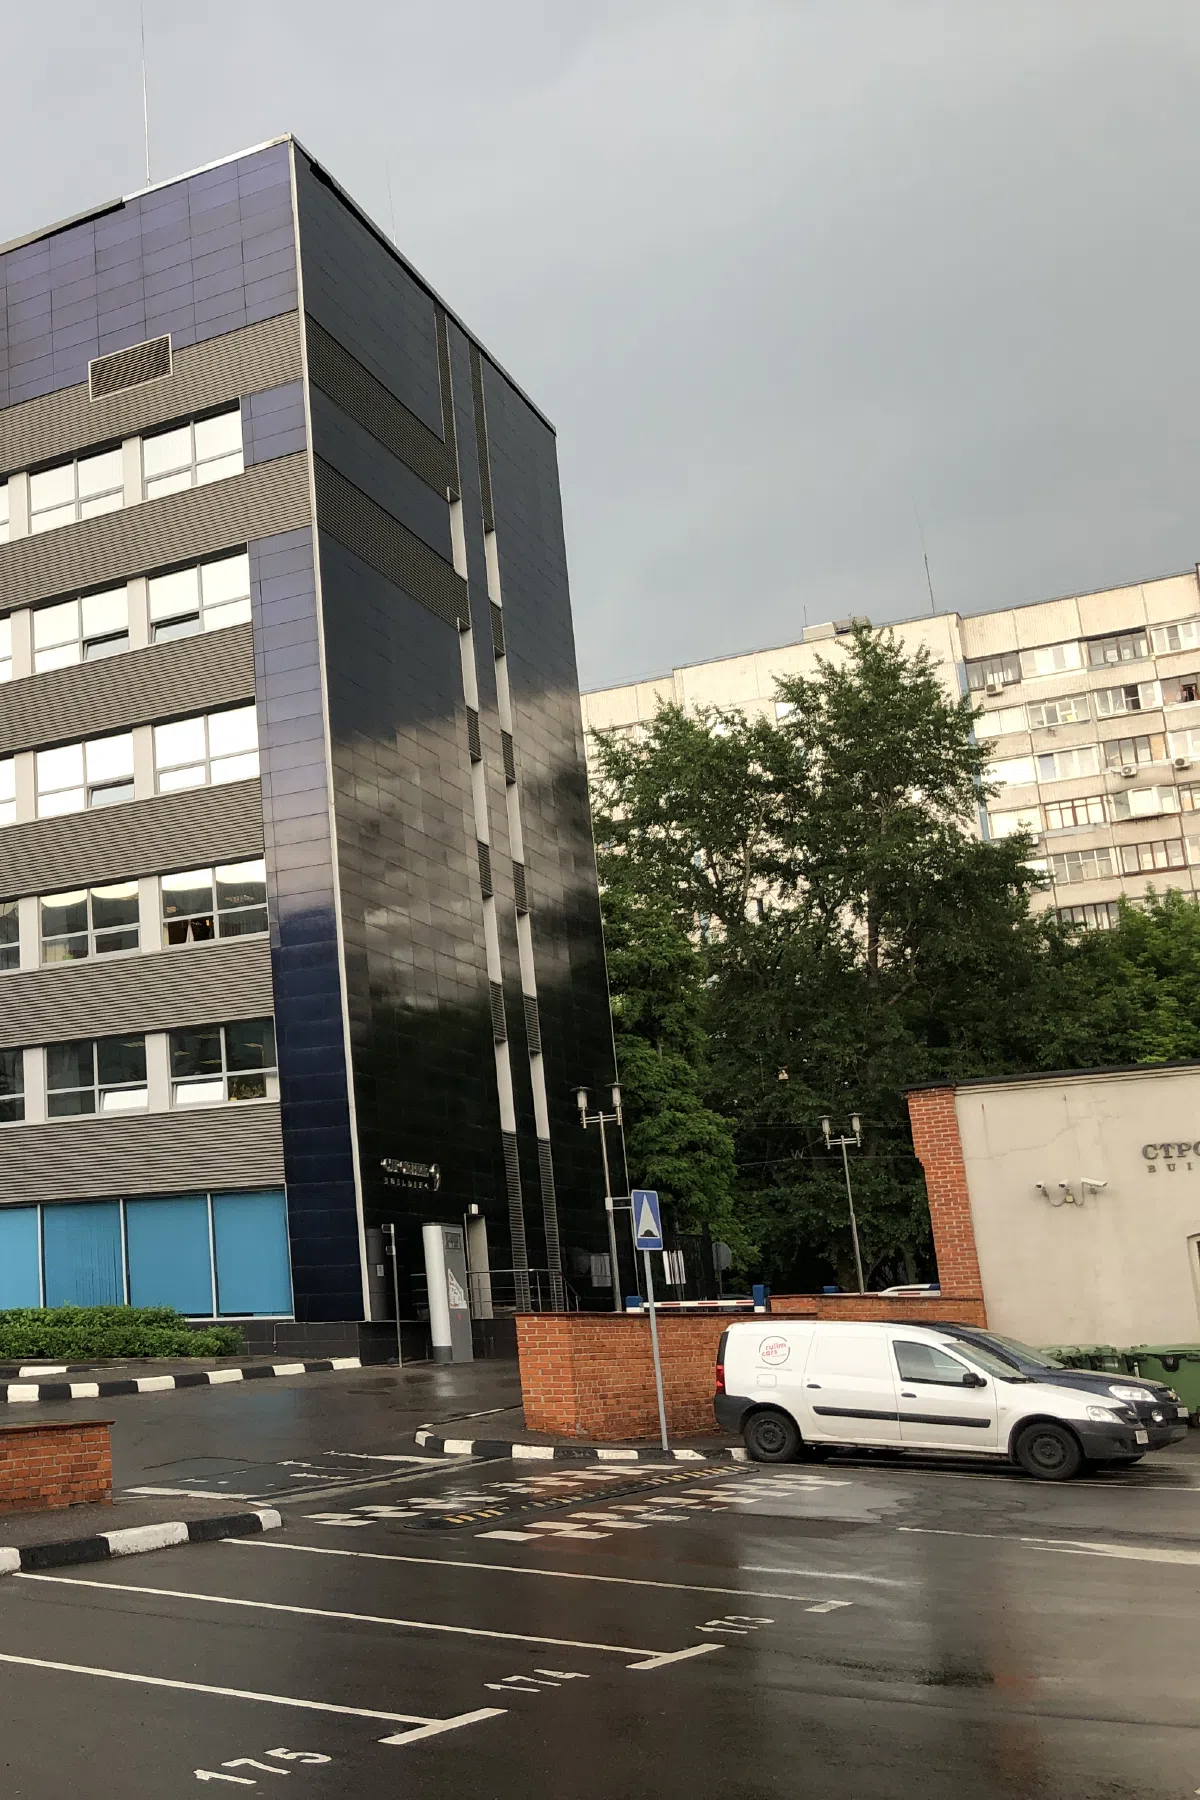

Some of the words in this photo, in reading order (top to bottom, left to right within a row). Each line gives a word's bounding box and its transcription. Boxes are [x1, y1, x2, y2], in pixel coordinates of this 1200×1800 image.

[1147, 1162, 1193, 1173] BUI
[695, 1615, 775, 1634] 173
[483, 1668, 591, 1692] 174
[193, 1747, 332, 1784] 175
